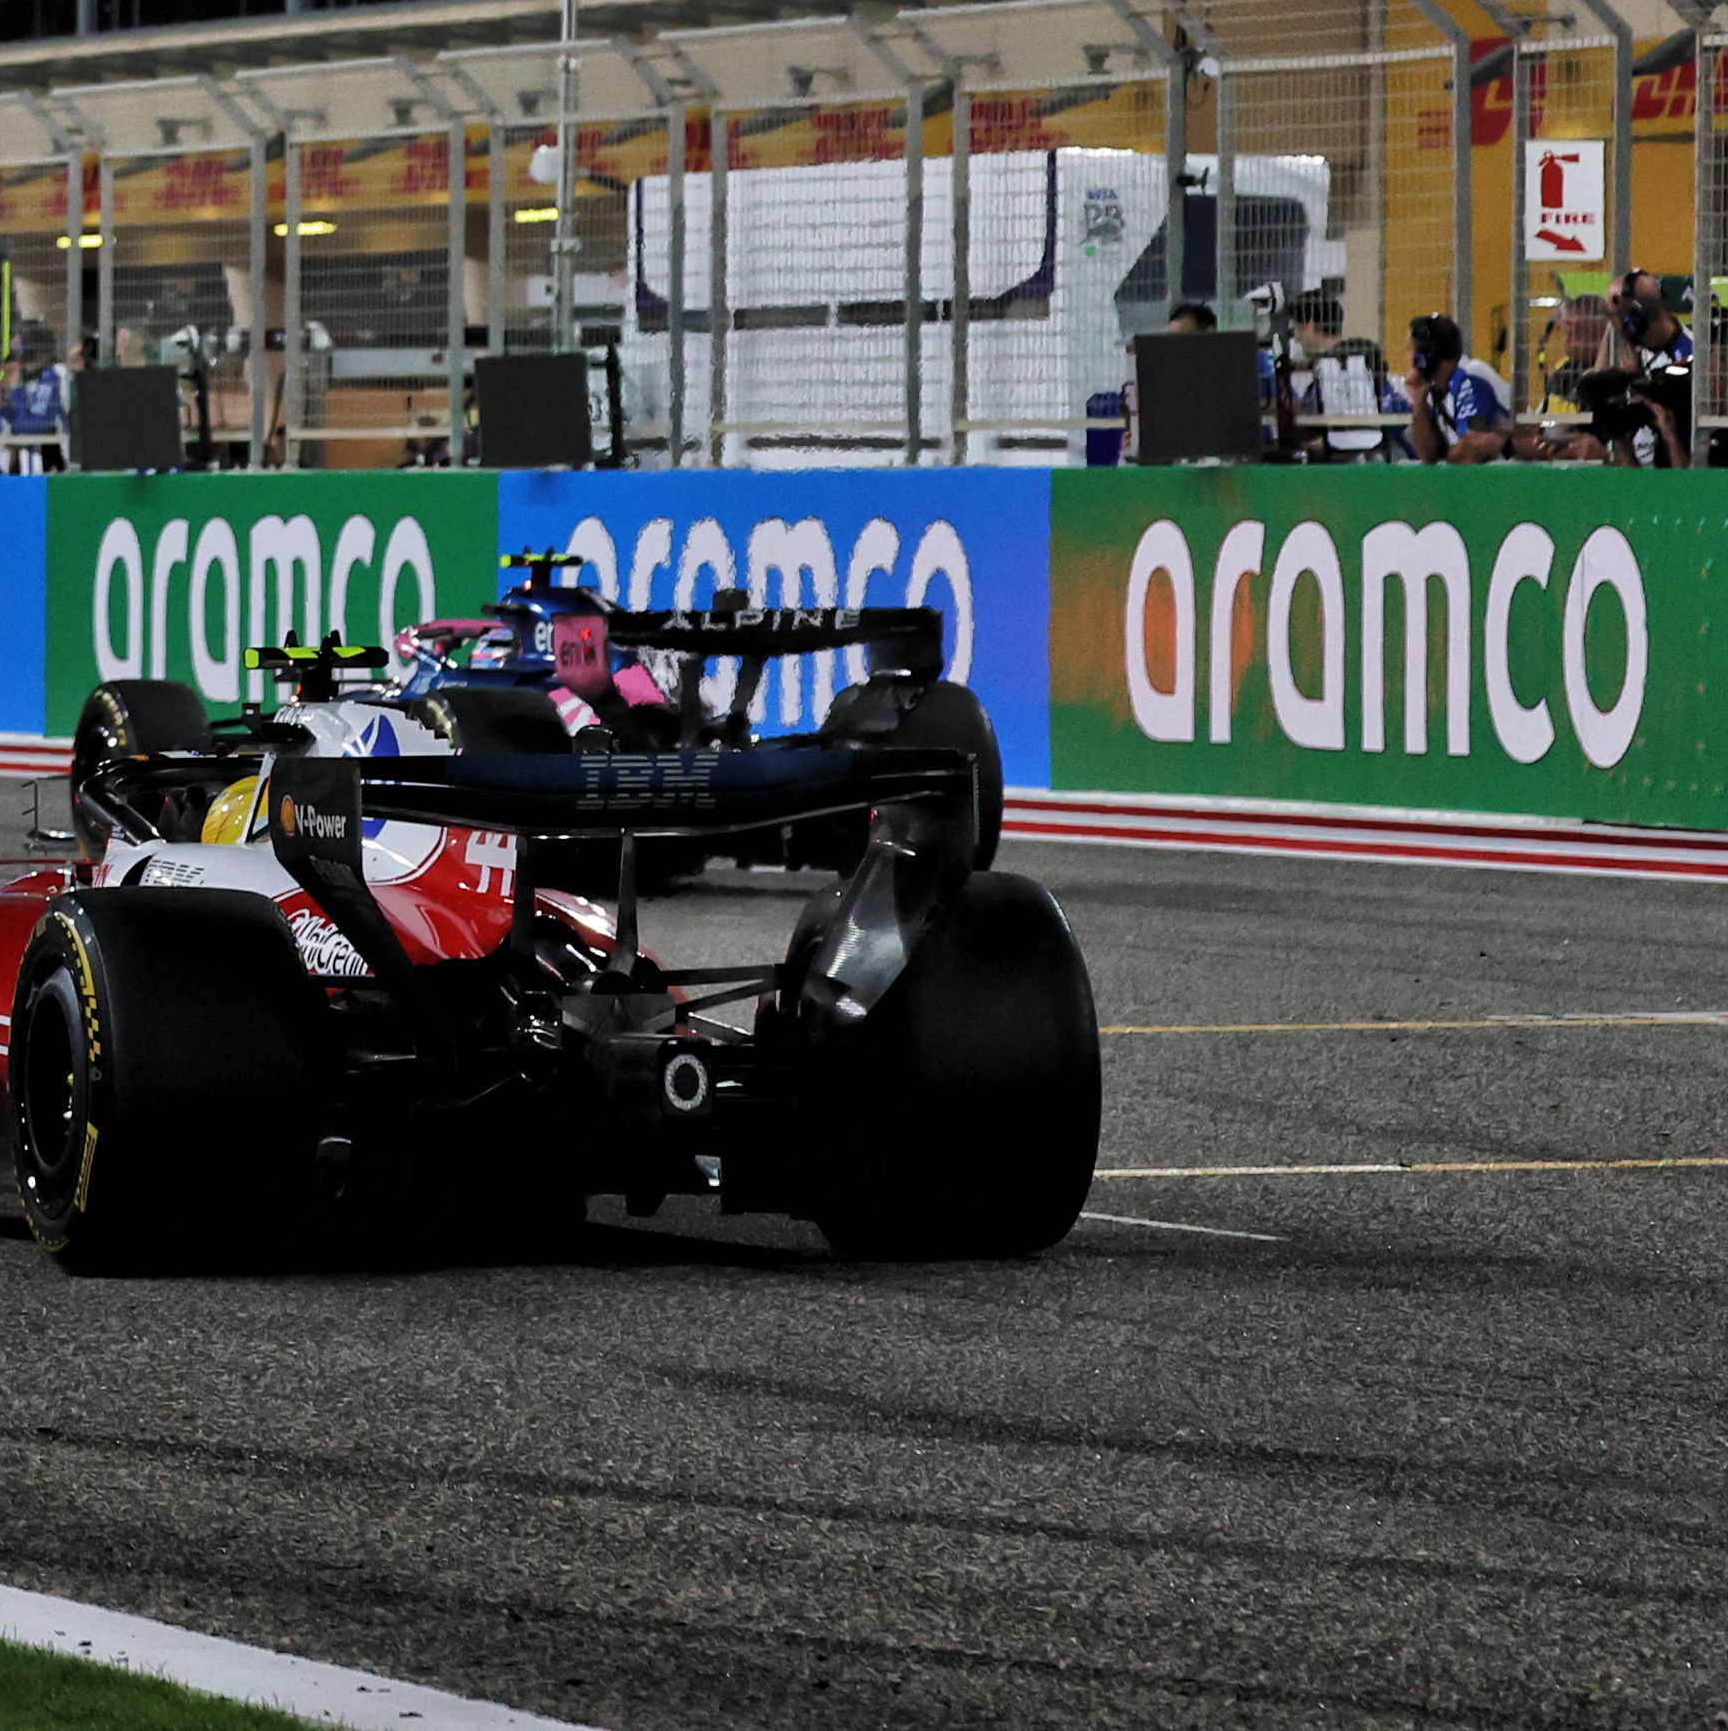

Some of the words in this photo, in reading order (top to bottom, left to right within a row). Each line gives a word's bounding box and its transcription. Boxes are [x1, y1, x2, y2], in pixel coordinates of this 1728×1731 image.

[1541, 212, 1594, 224] FIRE
[93, 514, 436, 703] aramco
[1124, 519, 1648, 769] aramco
[576, 754, 719, 810] IBM
[295, 804, 346, 838] V-Power
